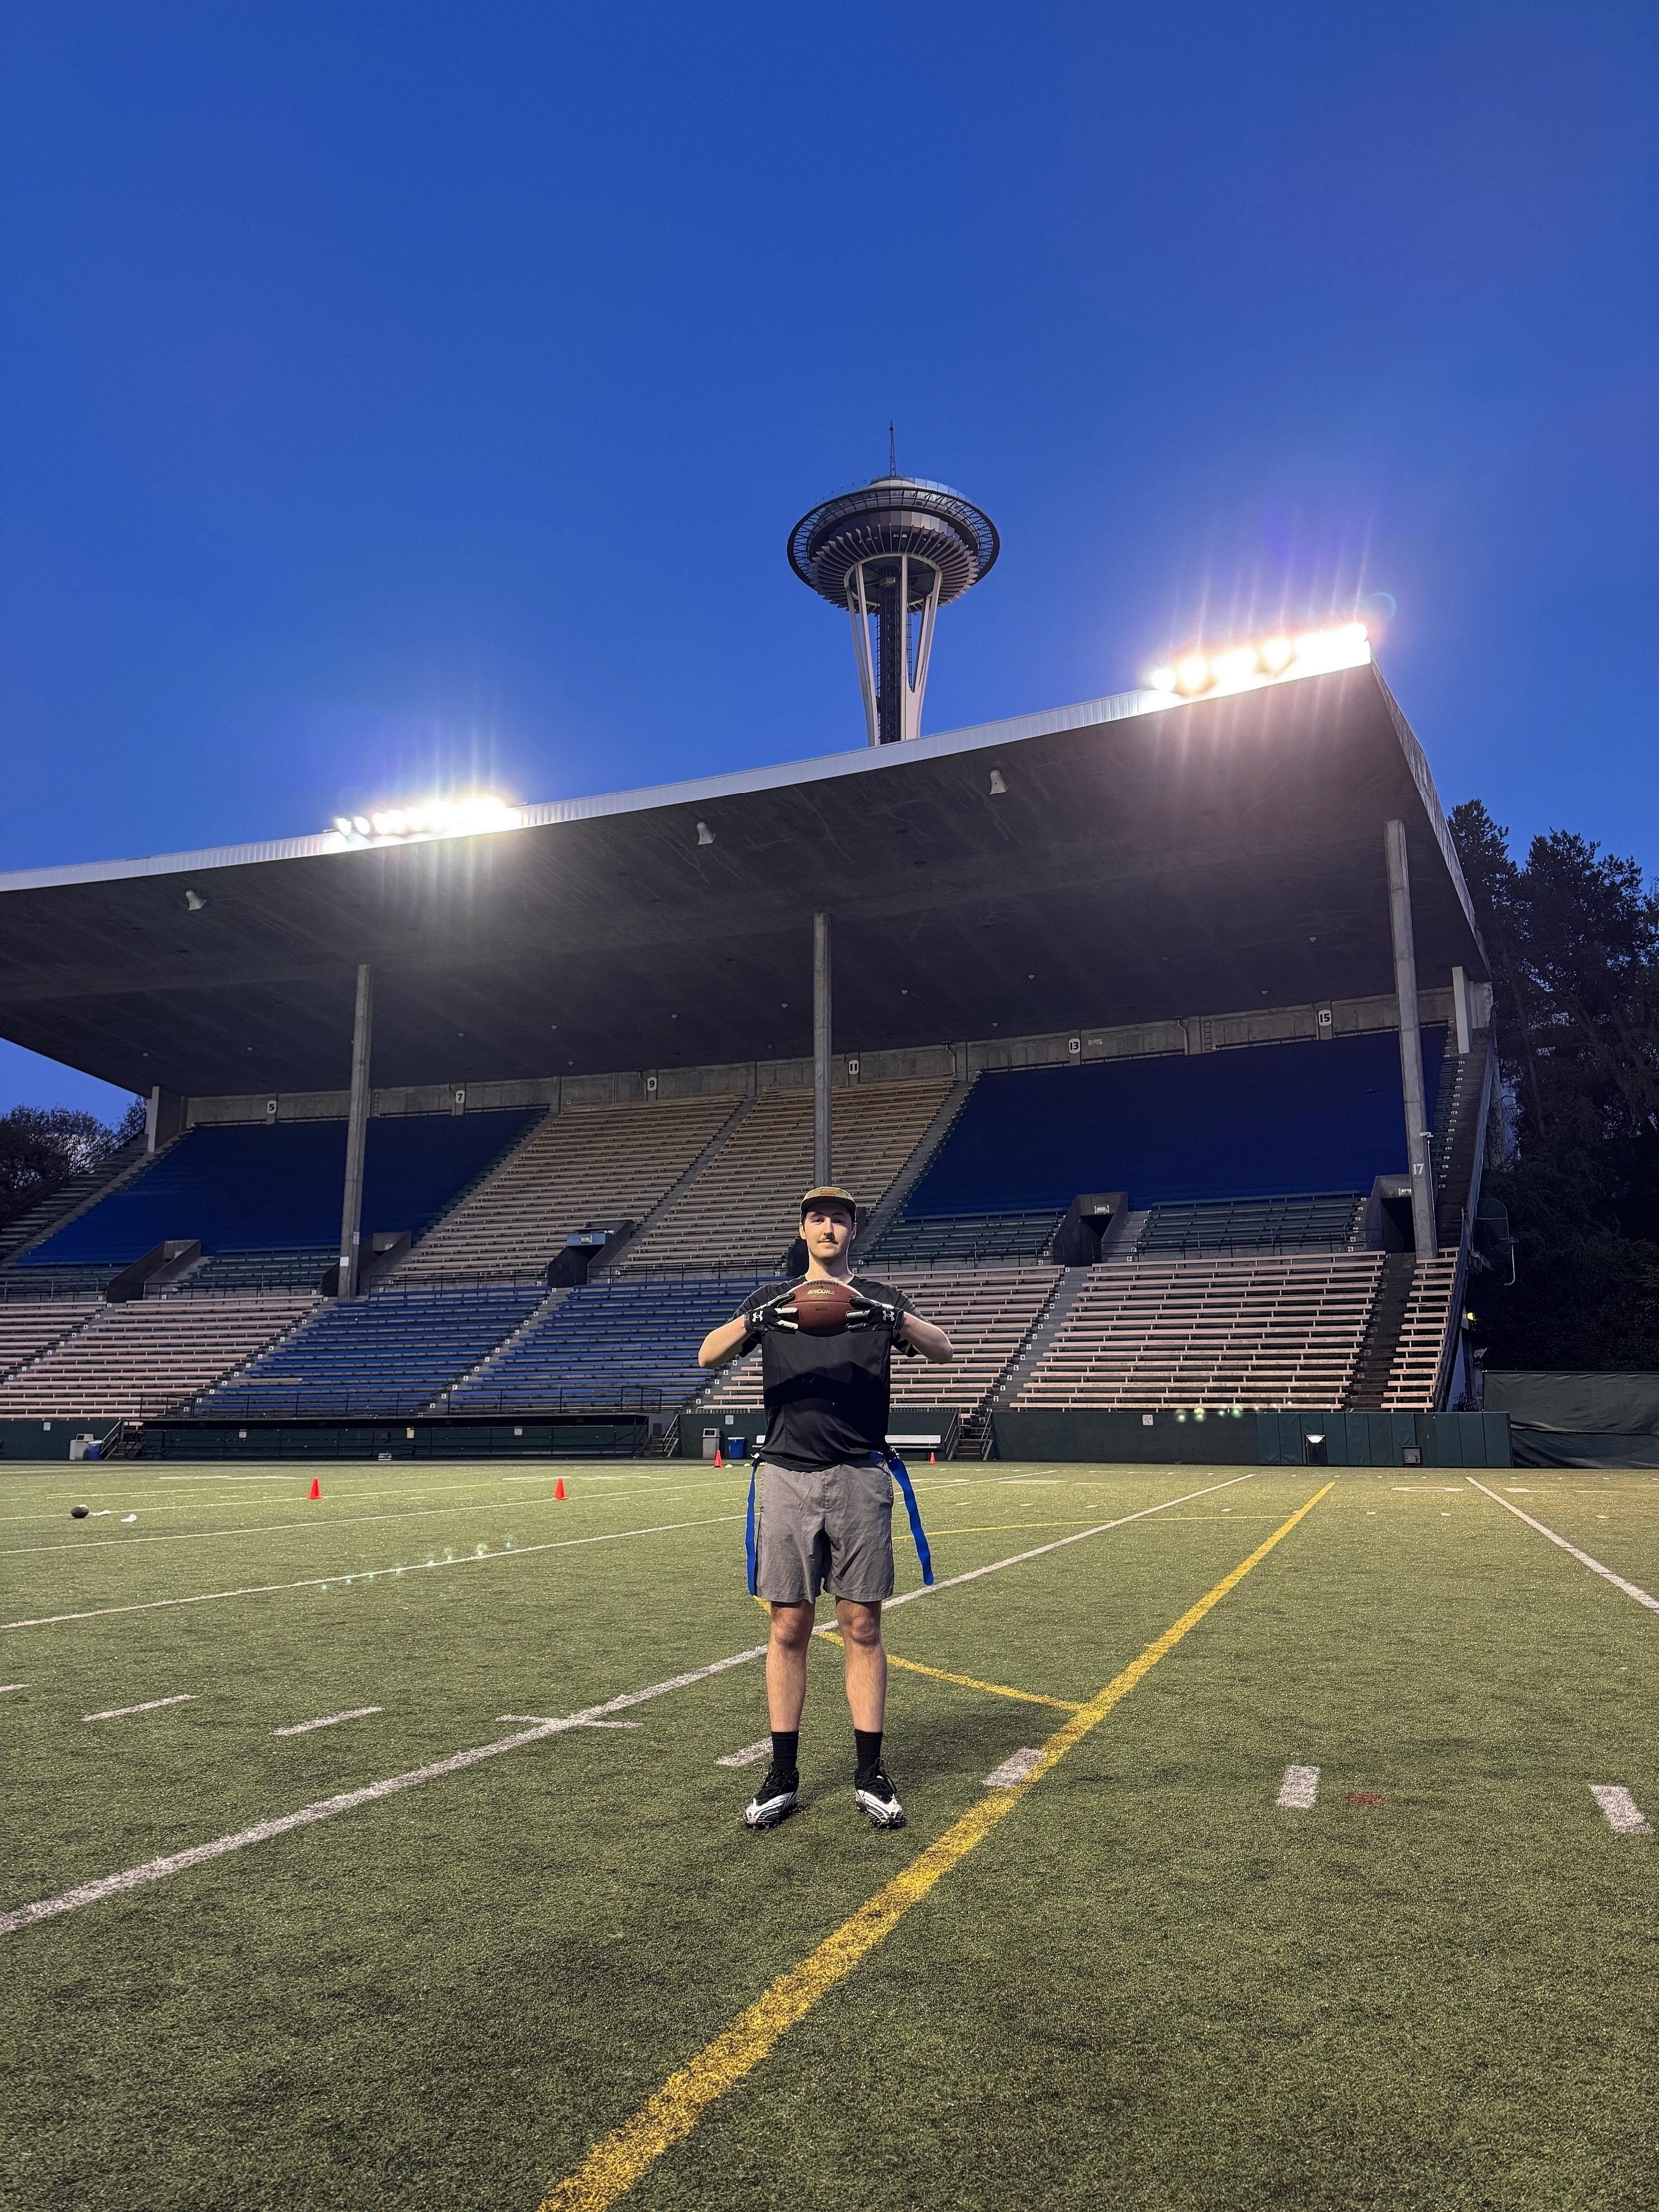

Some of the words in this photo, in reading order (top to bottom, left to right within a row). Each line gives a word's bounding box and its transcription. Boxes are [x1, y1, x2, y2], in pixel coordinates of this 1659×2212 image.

[1320, 1013, 1330, 1022] 15
[1070, 1042, 1078, 1050] 13
[1413, 1163, 1424, 1175] 17
